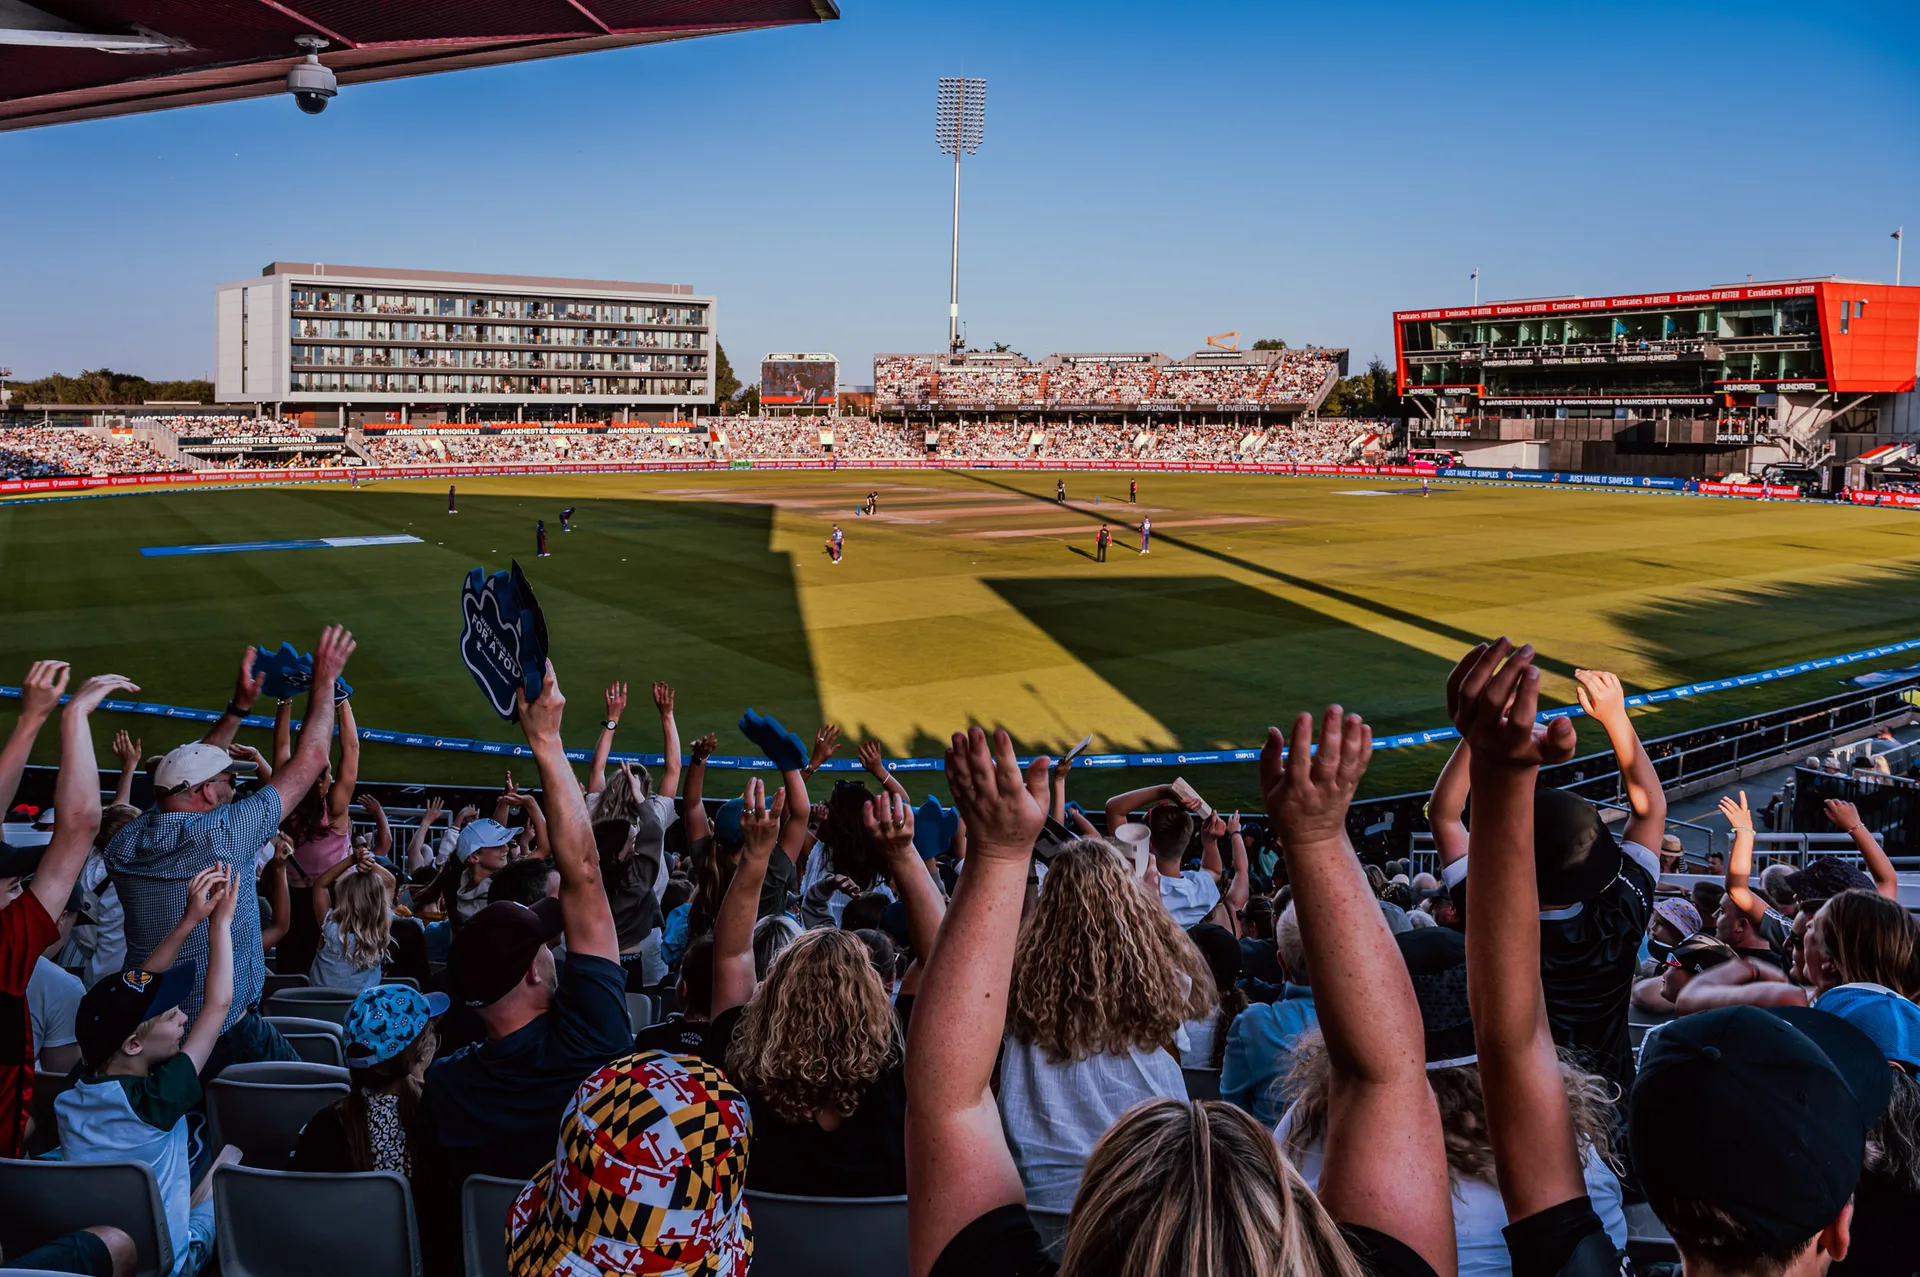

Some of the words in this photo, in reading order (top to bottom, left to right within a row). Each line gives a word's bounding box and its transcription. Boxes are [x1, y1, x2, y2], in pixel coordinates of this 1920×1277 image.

[1747, 288, 1782, 297] Emirates
[1785, 287, 1794, 295] FLY
[1795, 285, 1815, 294] BETTER
[1677, 293, 1710, 302] Emirates
[1608, 477, 1633, 485] SIMPLES
[472, 614, 488, 642] FOR
[489, 641, 495, 654] A
[498, 651, 520, 677] FOU
